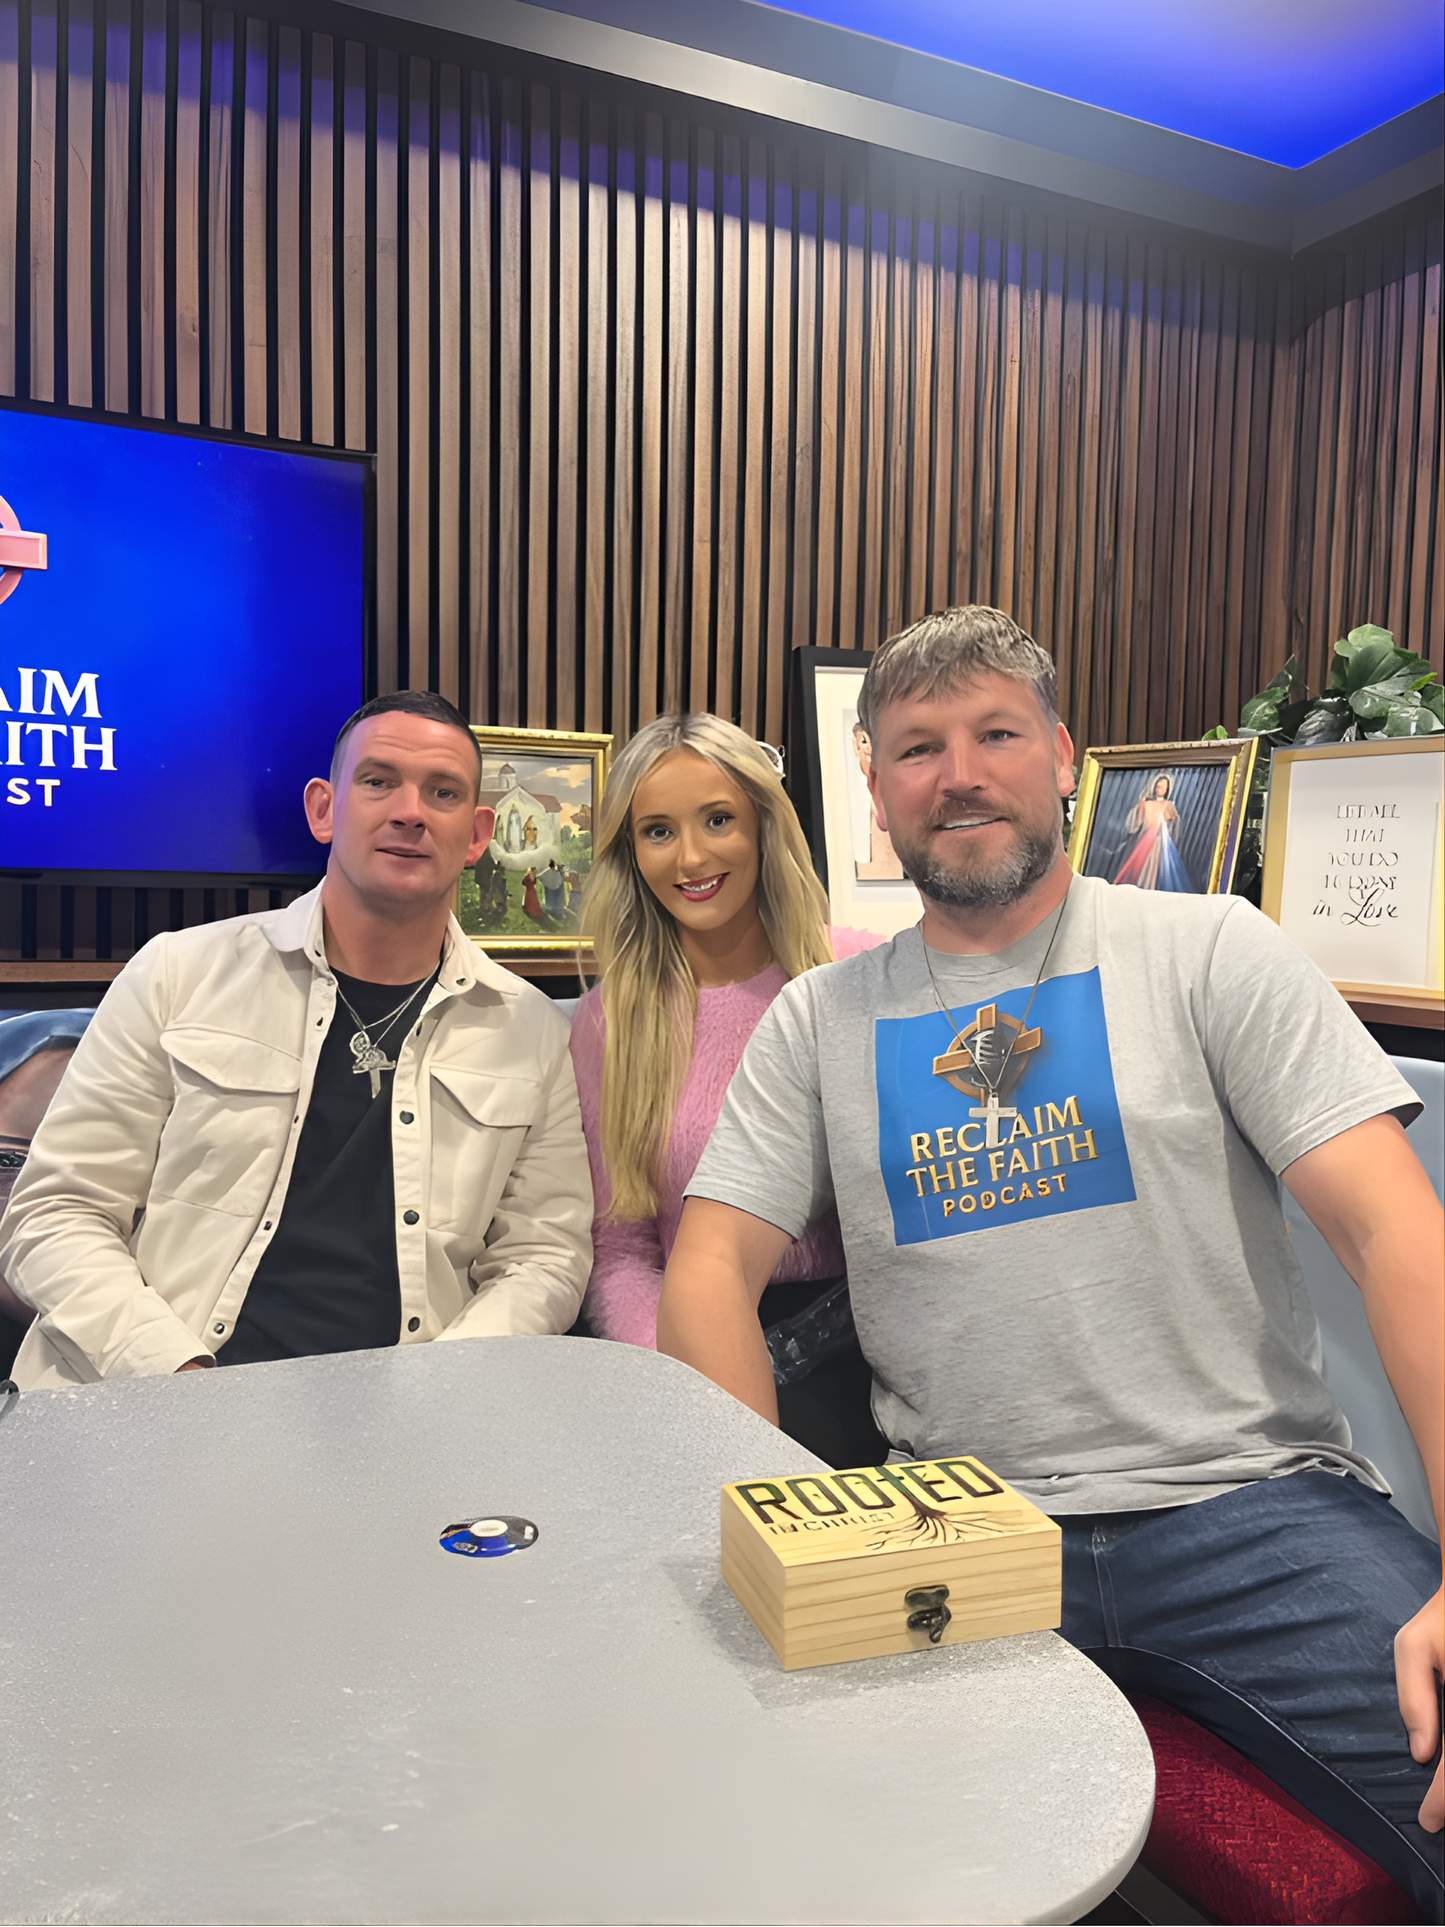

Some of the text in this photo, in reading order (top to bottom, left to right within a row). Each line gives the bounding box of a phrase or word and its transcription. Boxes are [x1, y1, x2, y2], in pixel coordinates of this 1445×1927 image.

[0, 720, 118, 771] ITH
[905, 1129, 1100, 1198] THE FAITH
[942, 1173, 1068, 1218] PODCAST
